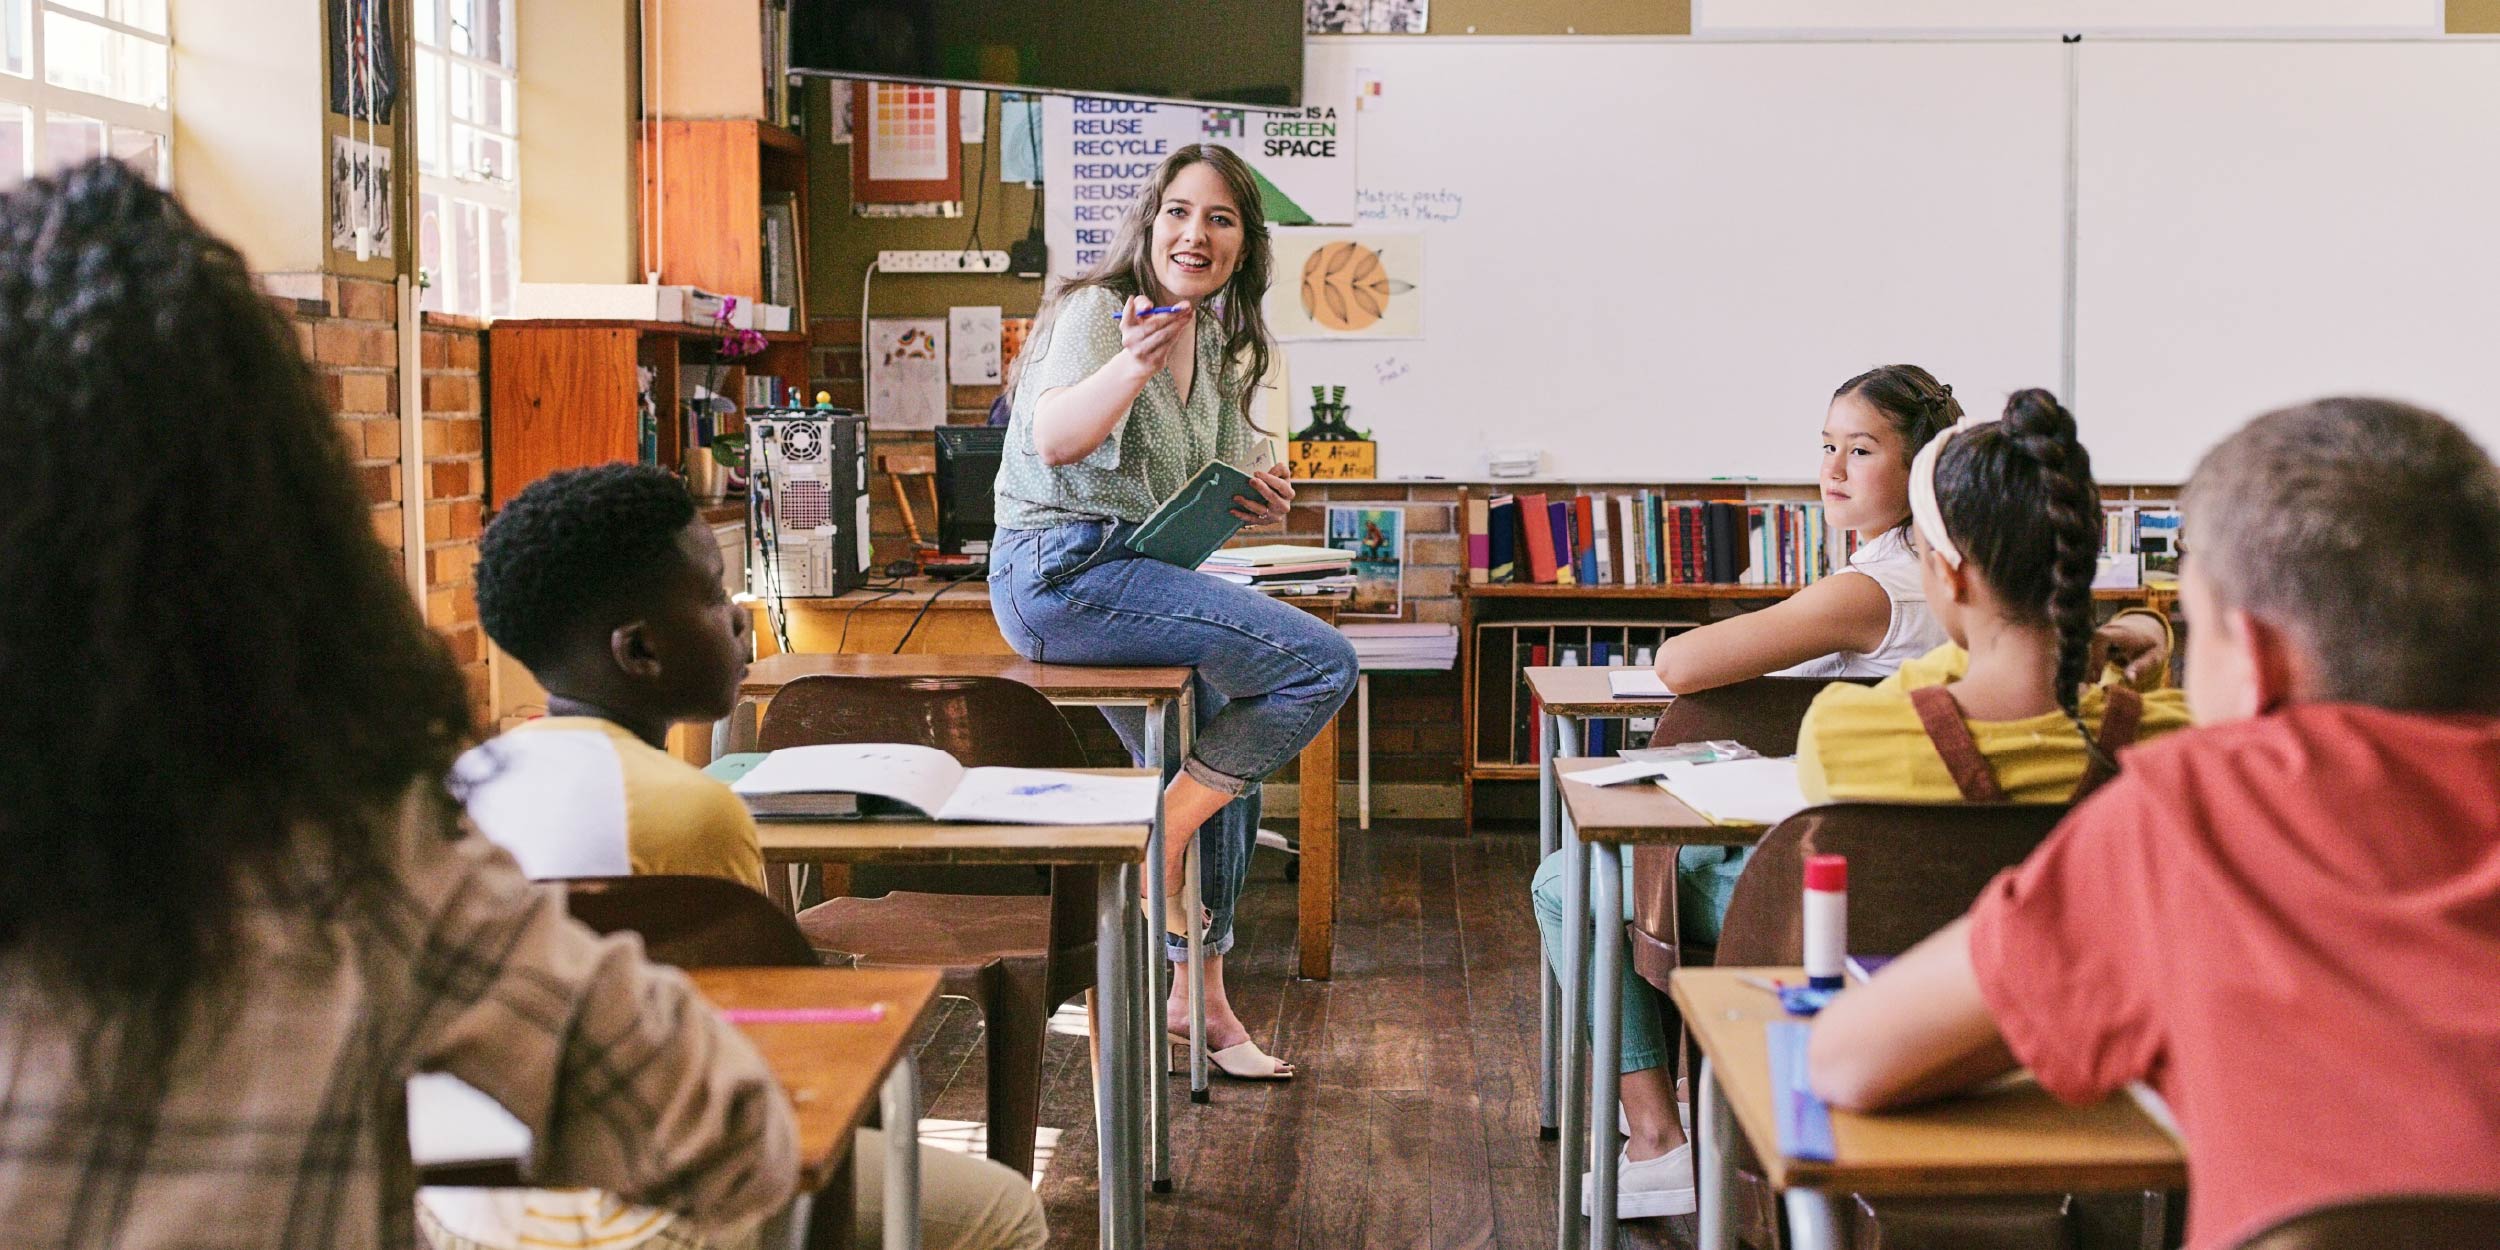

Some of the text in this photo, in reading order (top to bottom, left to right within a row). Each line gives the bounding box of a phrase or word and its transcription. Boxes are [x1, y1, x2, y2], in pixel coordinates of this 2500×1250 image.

[1073, 97, 1157, 113] REDUCE
[1306, 106, 1322, 119] IS
[1325, 107, 1337, 119] A
[1073, 119, 1142, 135] REUSE
[1263, 121, 1336, 138] GREEN
[1073, 139, 1168, 156] RECYCLE
[1263, 139, 1337, 157] SPACE
[1074, 205, 1130, 221] RECY
